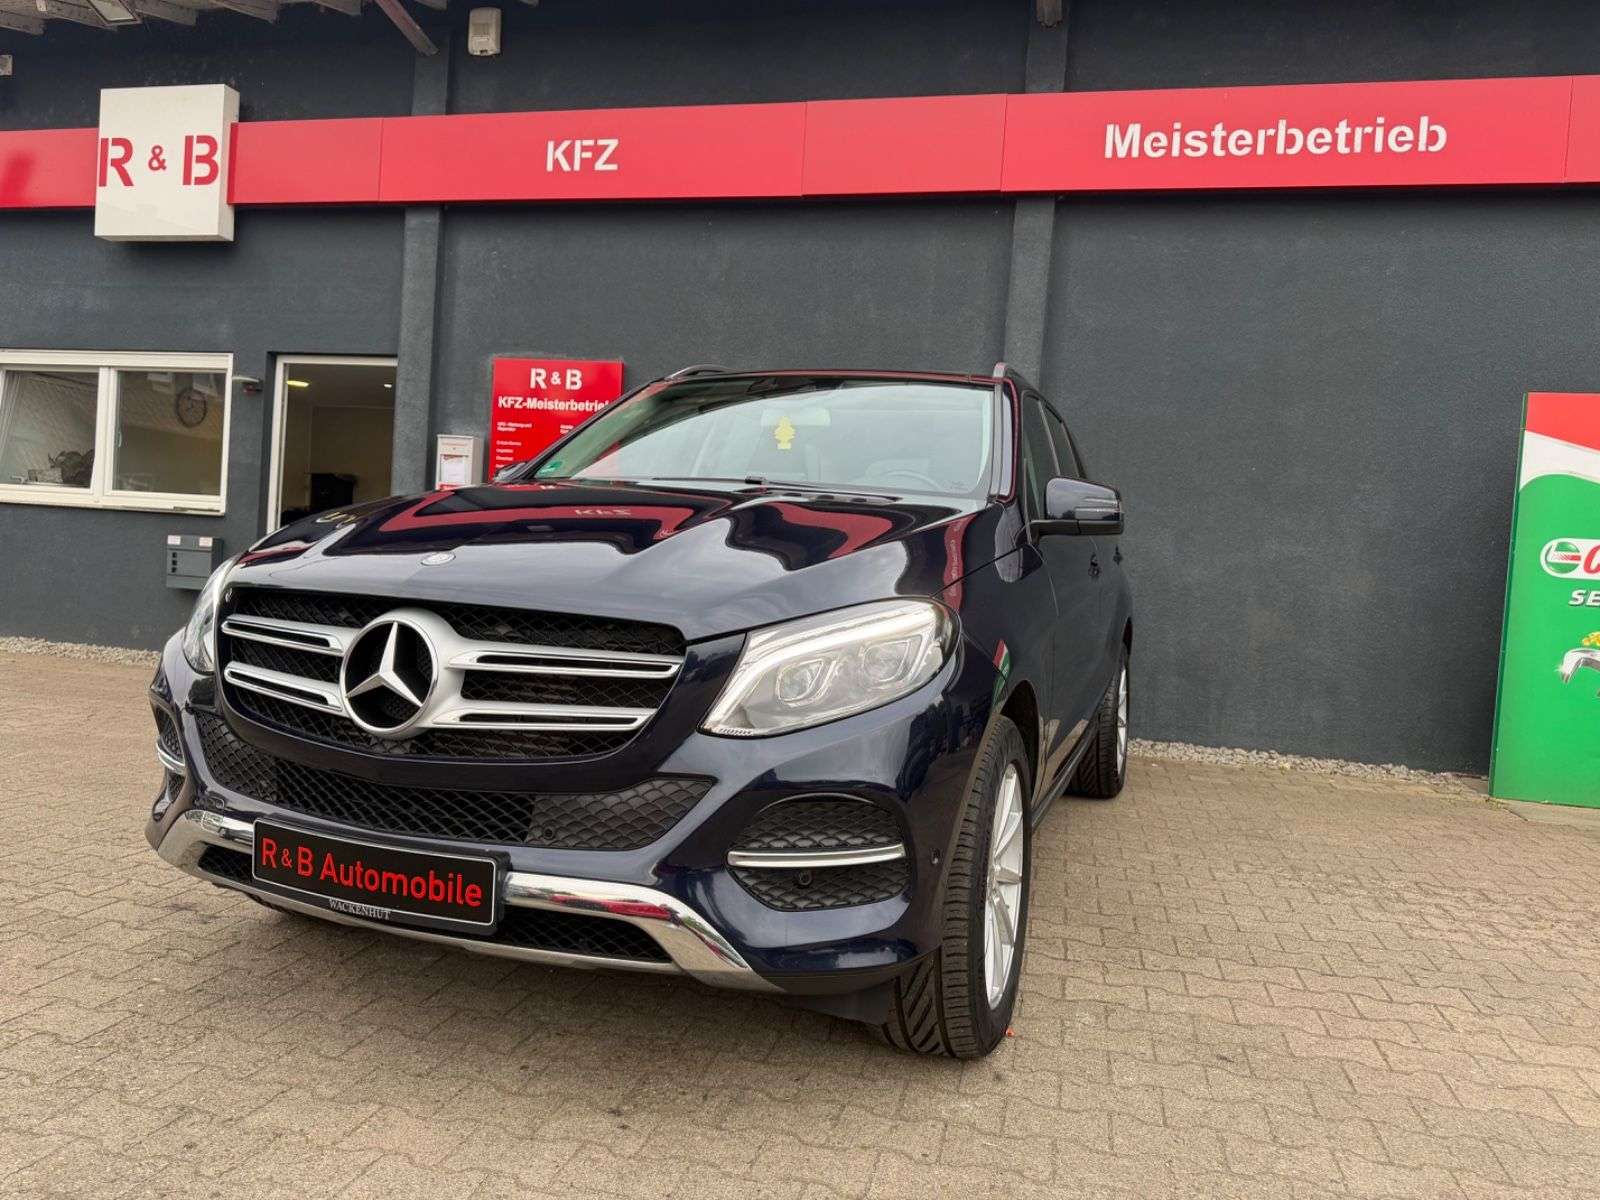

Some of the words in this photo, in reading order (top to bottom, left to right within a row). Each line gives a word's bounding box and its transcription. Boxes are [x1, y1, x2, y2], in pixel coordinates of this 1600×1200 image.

[98, 137, 135, 187] R
[147, 144, 167, 171] &
[182, 134, 220, 186] B
[546, 139, 619, 172] KFZ
[1104, 115, 1448, 159] Meisterbetrieb
[530, 367, 547, 389] R
[551, 371, 561, 385] &
[565, 368, 582, 390] B
[262, 837, 278, 869] R
[281, 848, 293, 869] &
[297, 846, 314, 877] B
[320, 852, 483, 908] Automobile
[329, 899, 391, 920] WACKENHUT
